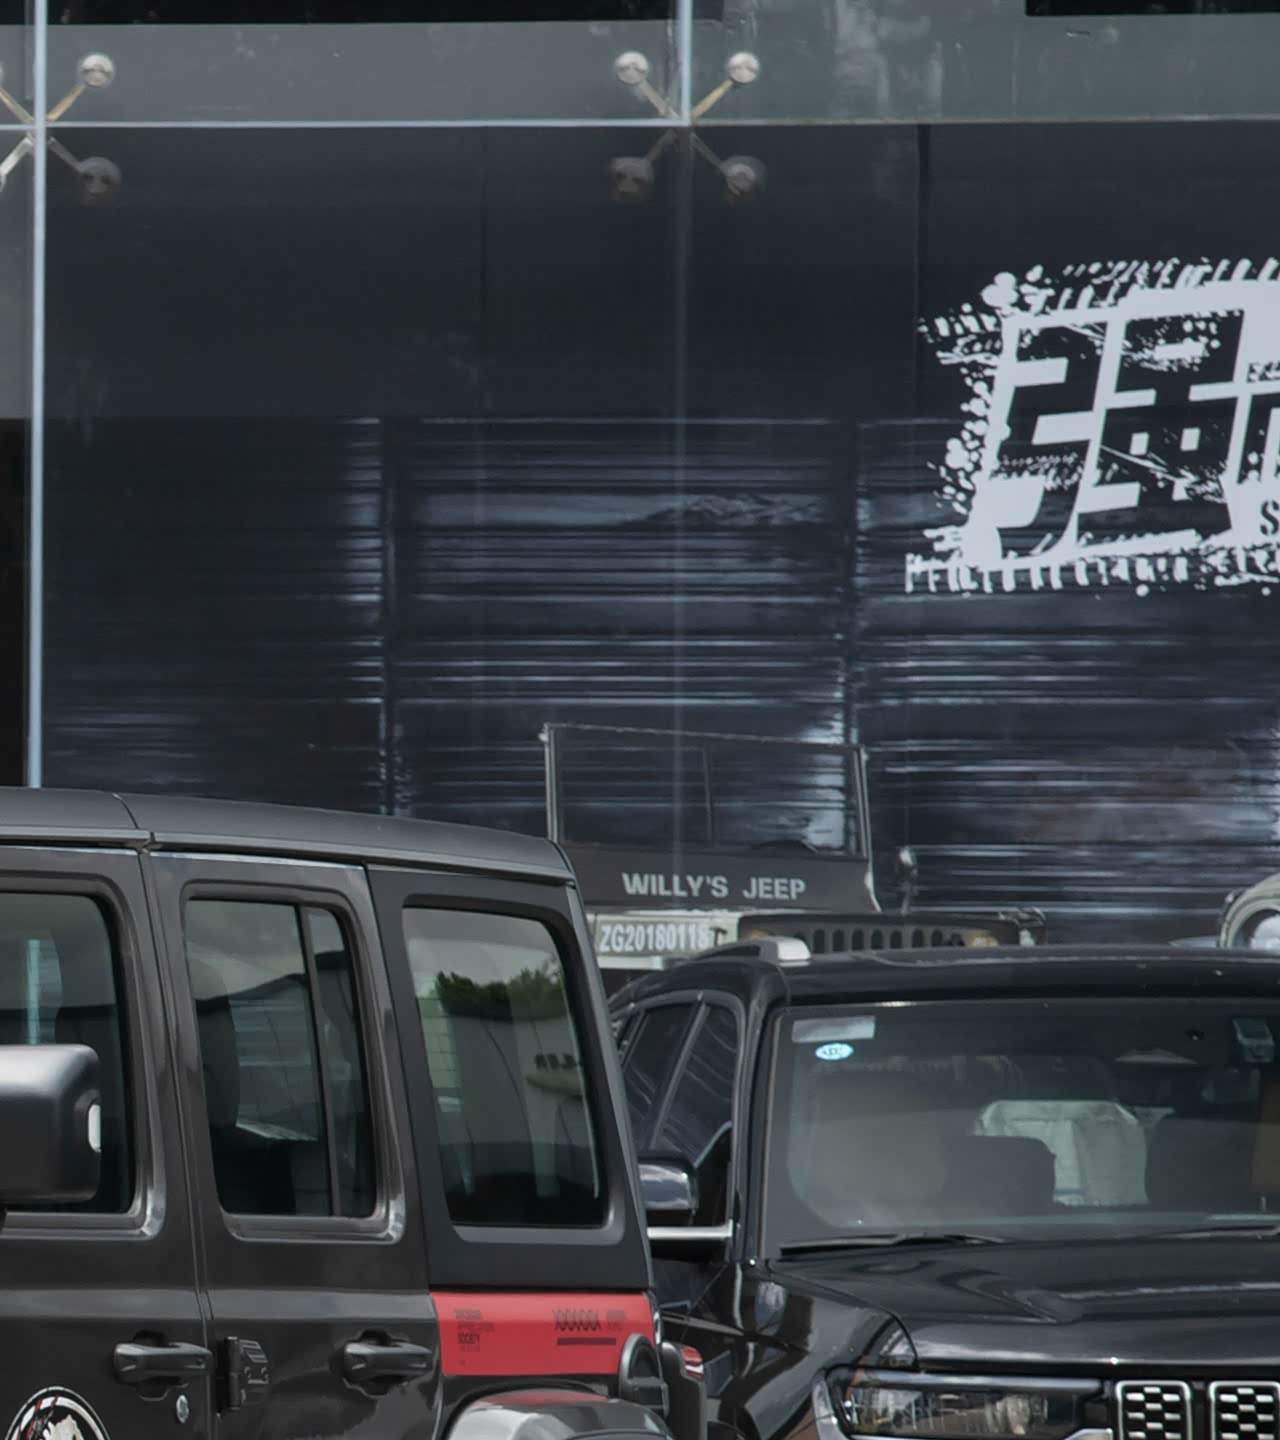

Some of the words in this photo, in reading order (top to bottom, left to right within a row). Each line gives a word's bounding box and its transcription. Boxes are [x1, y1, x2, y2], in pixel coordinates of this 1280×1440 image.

[622, 872, 728, 898] WILLY'S
[743, 876, 806, 900] JEEP
[599, 923, 709, 953] ZG20180118
